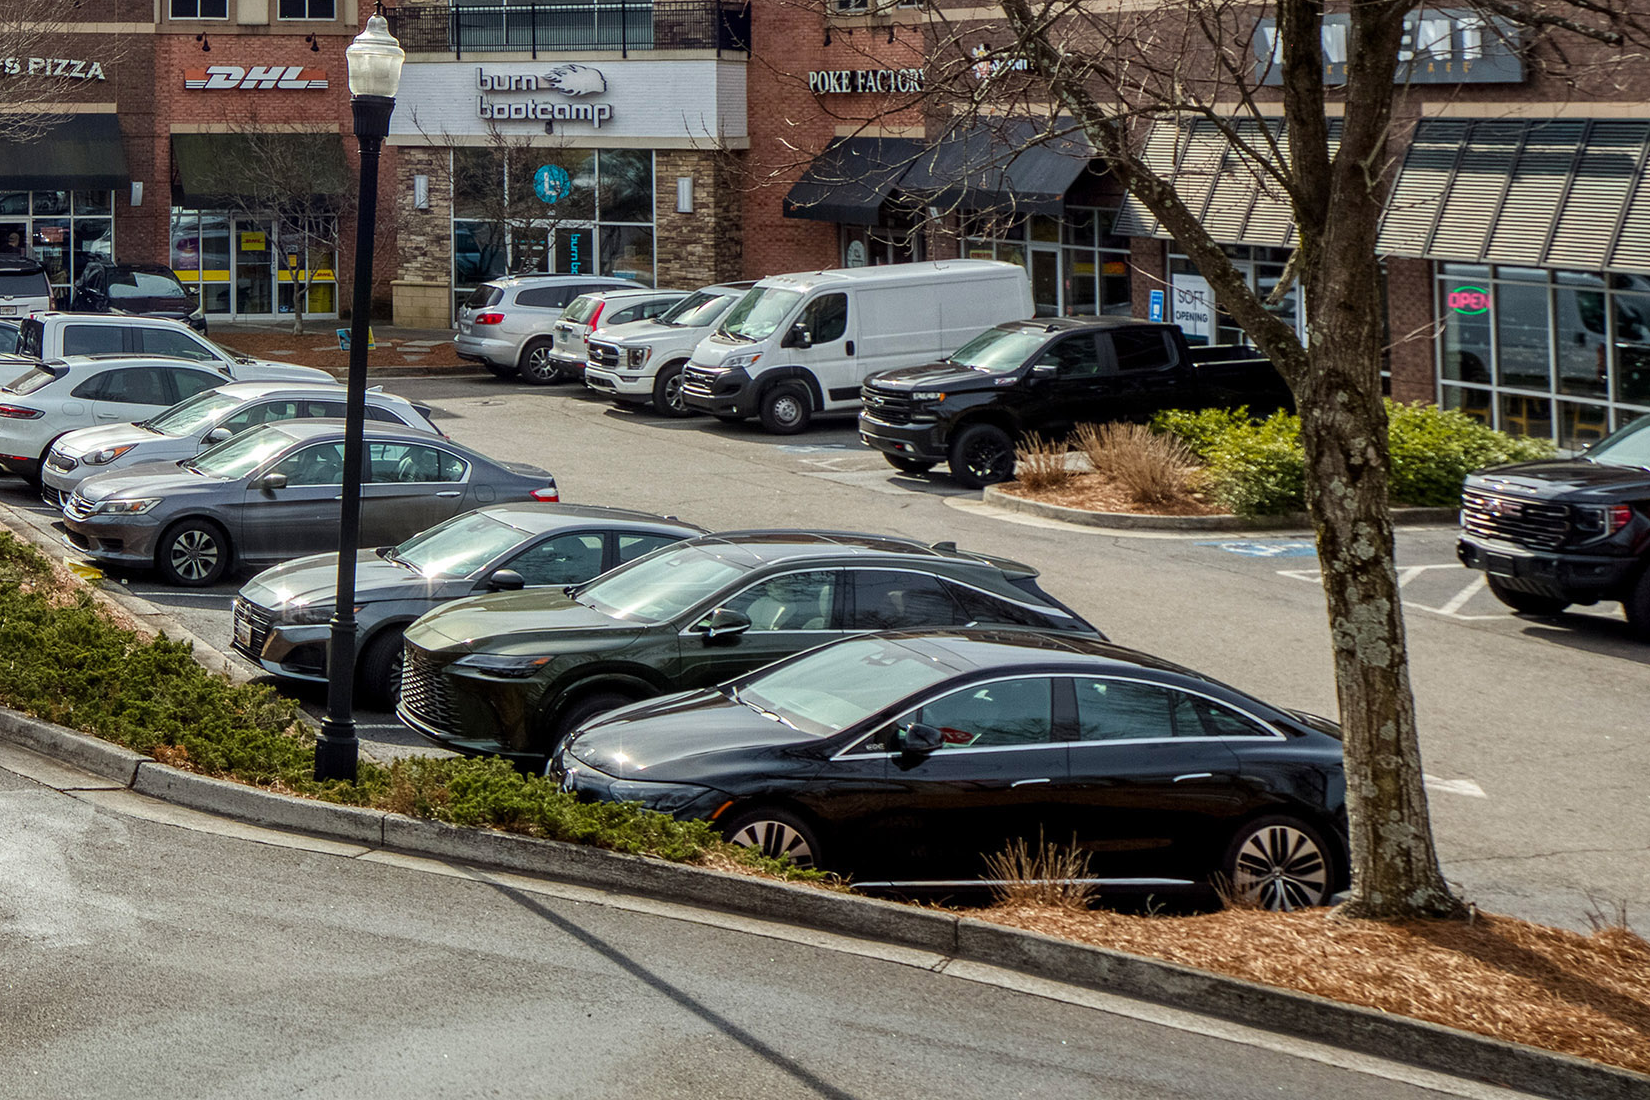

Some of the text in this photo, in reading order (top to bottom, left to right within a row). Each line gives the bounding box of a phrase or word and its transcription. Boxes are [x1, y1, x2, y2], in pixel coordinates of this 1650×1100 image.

[28, 56, 107, 81] PIZZA
[204, 65, 310, 90] DHL
[475, 67, 538, 91] burn
[809, 71, 852, 94] POKE
[475, 95, 613, 129] bootcamp
[570, 233, 581, 261] burn
[1178, 289, 1206, 305] SOFT
[1175, 310, 1209, 323] OPENING
